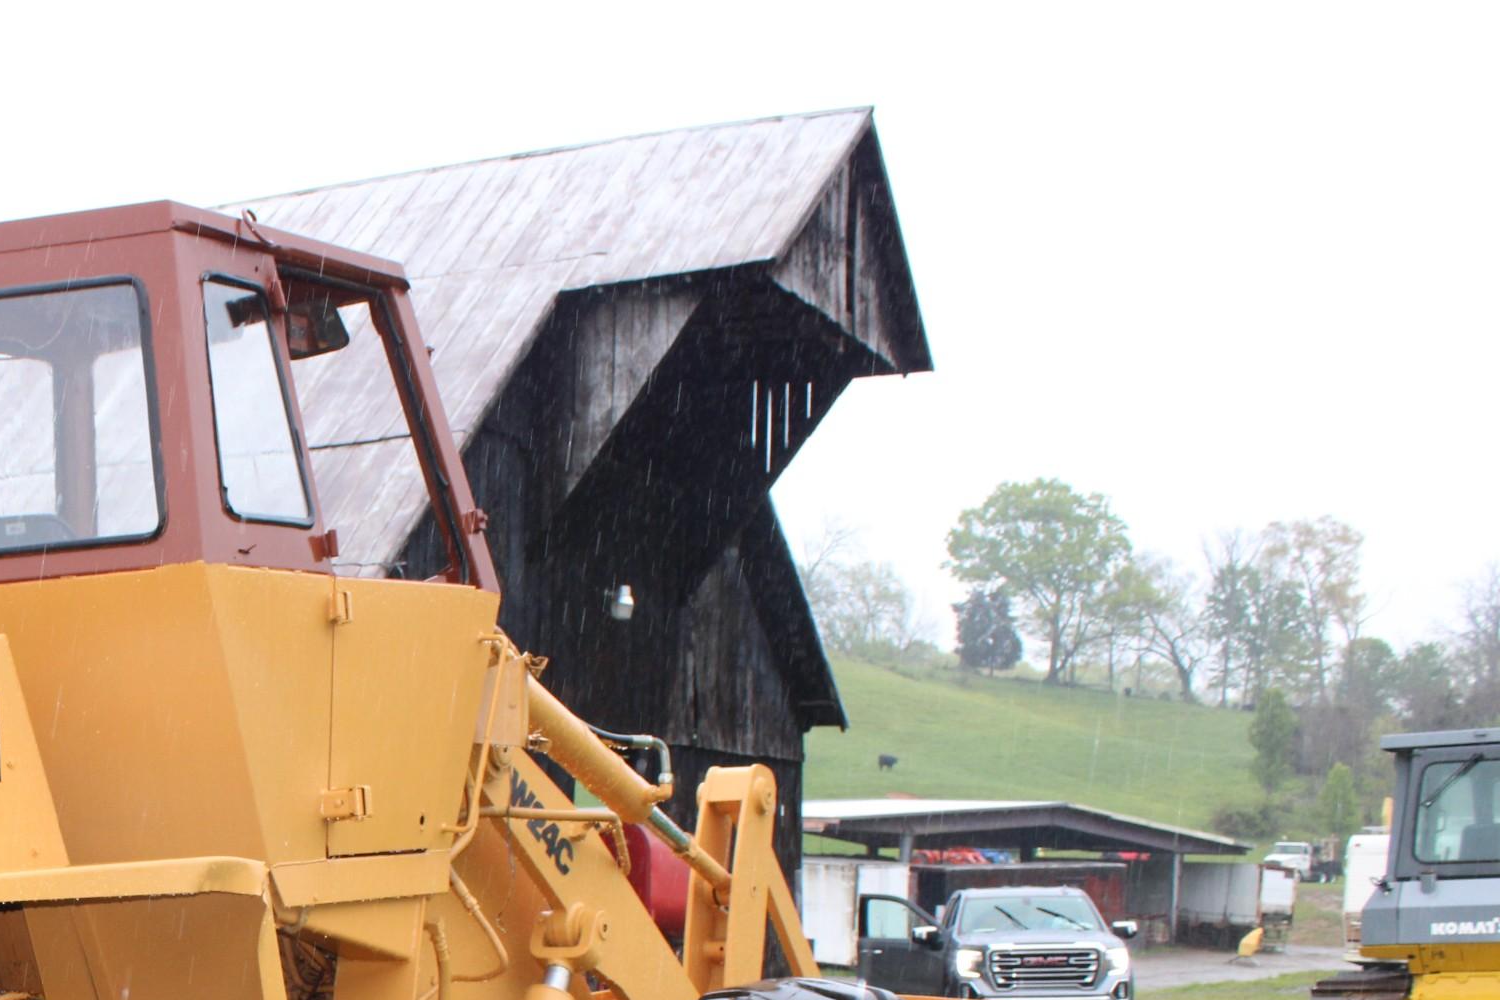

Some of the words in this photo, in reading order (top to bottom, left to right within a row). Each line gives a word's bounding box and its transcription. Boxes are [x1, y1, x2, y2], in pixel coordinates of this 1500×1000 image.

[510, 767, 574, 875] W24C
[1430, 917, 1500, 935] KOMAT
[1021, 956, 1068, 967] GMC
